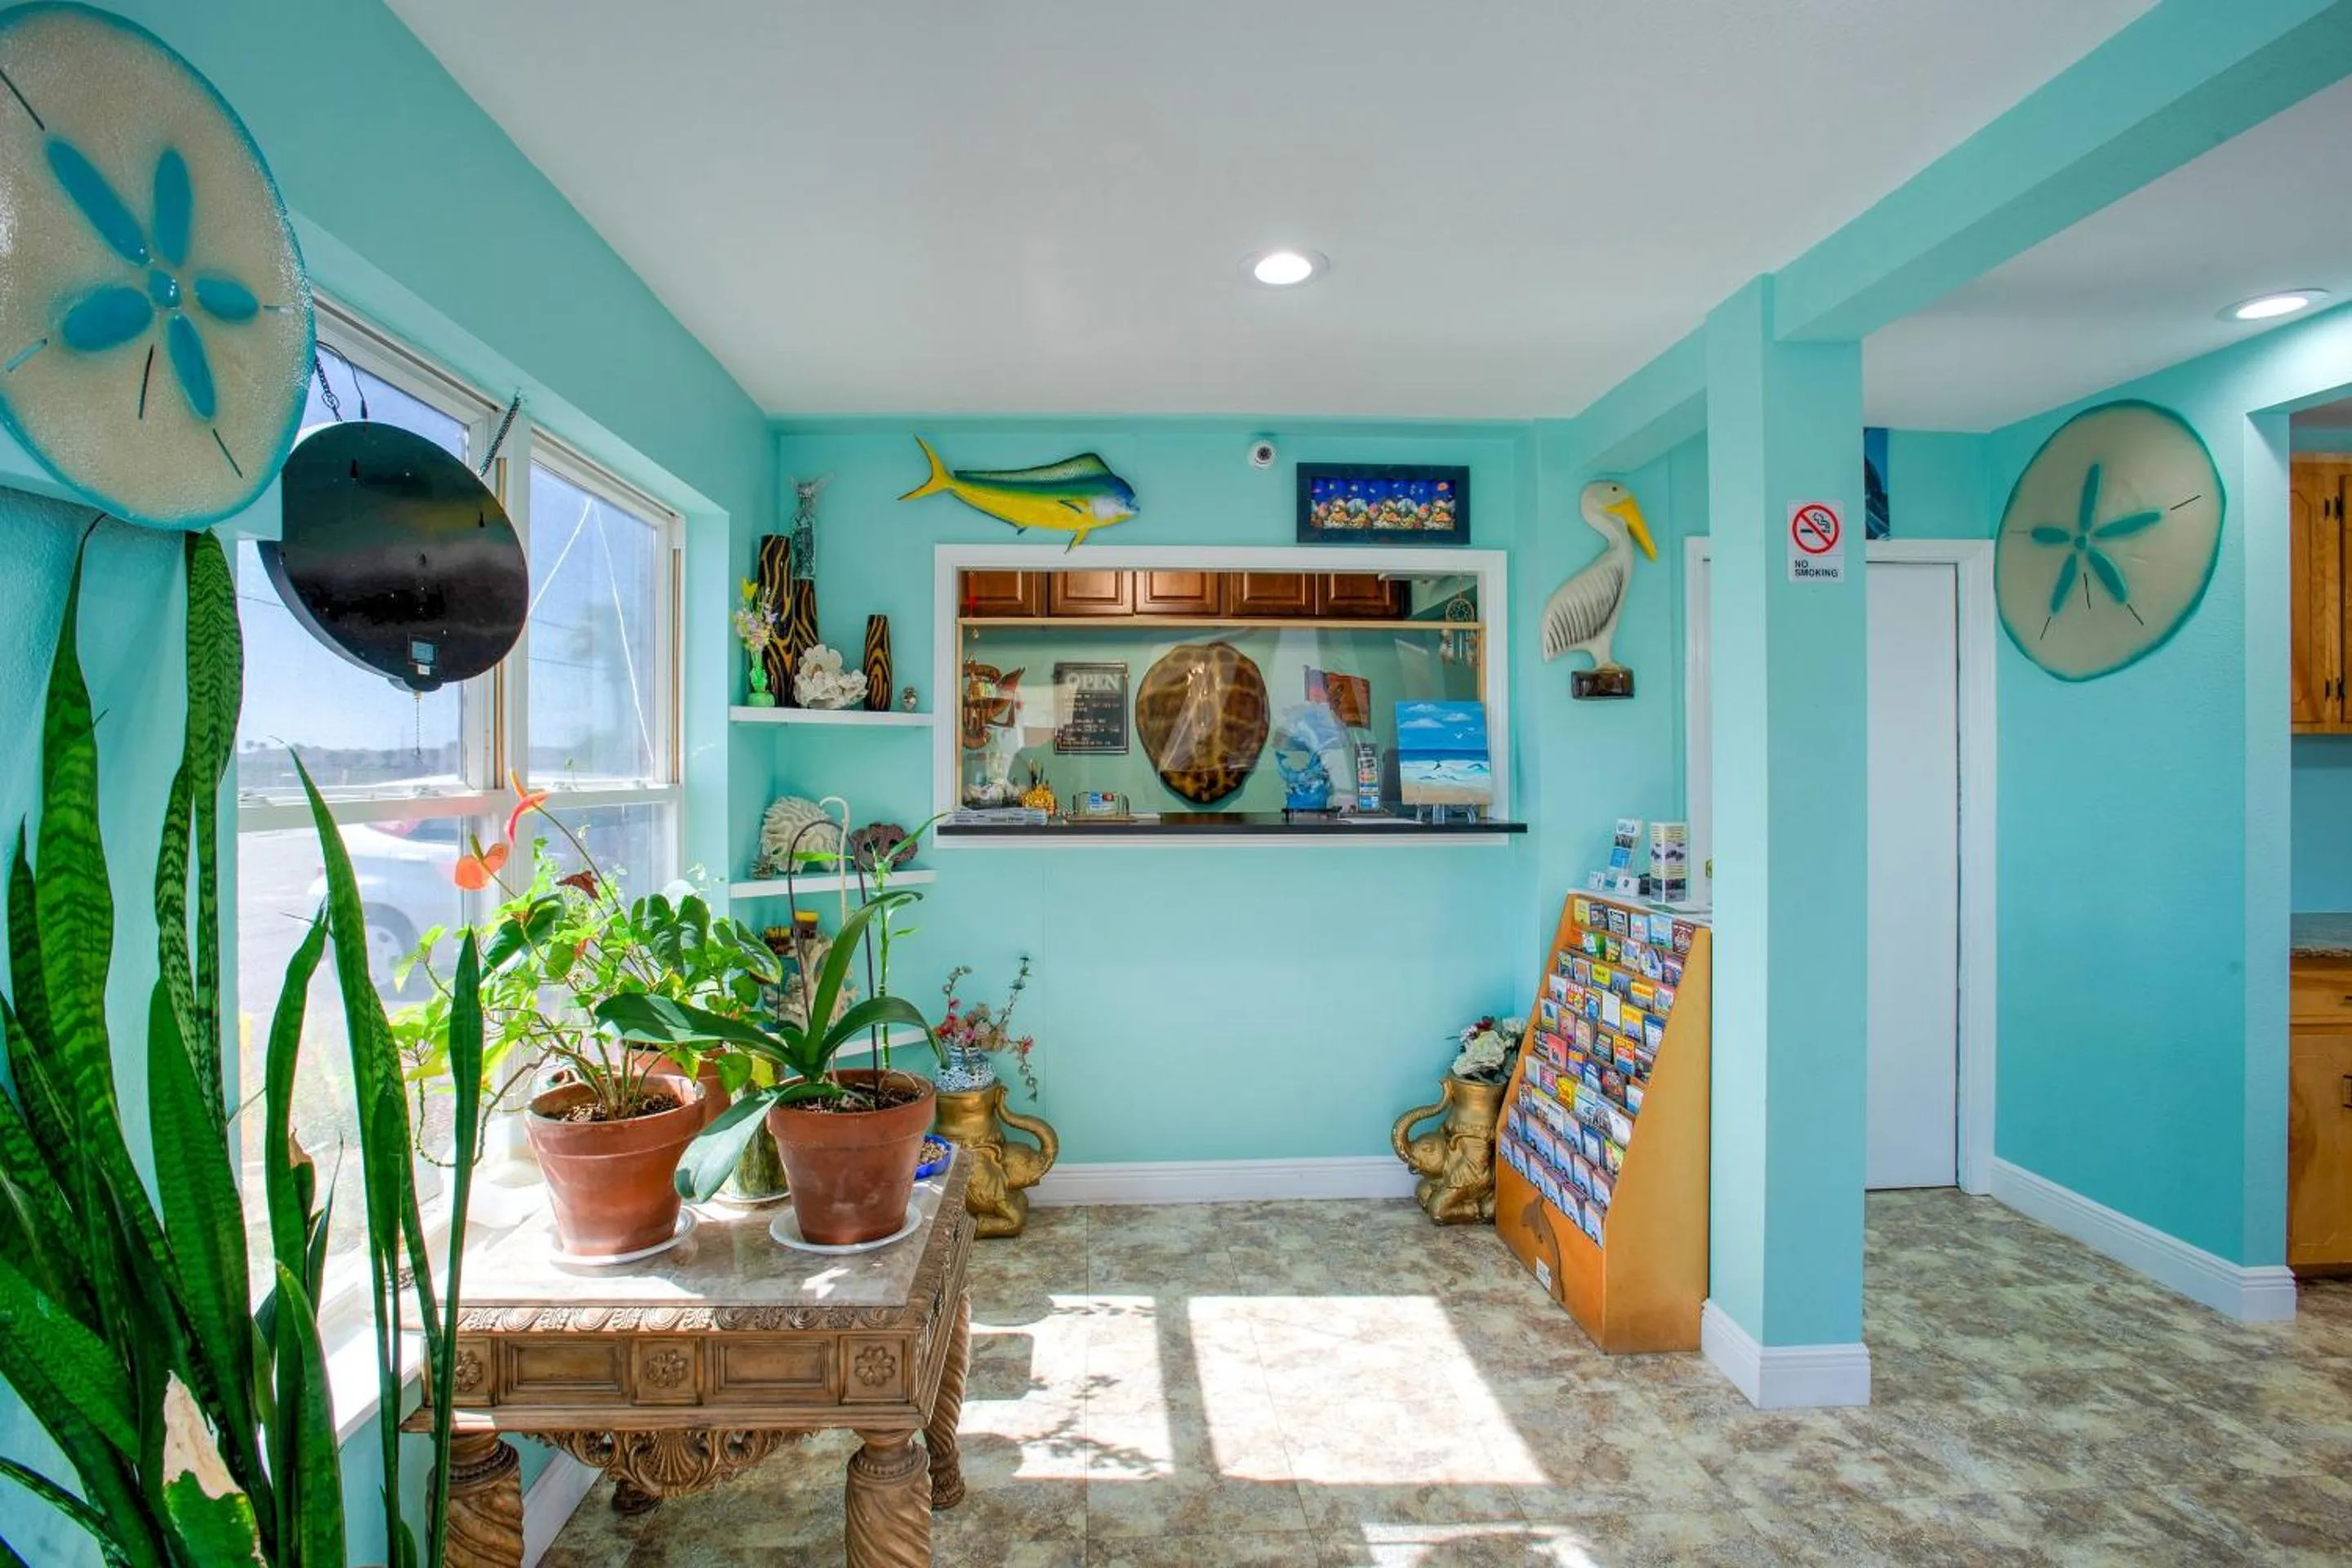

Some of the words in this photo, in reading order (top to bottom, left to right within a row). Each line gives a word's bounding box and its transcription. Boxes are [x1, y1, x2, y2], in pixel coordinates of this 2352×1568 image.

[1794, 559, 1809, 568] NO
[1794, 568, 1838, 577] SMOKING
[1065, 672, 1120, 690] OPEN
